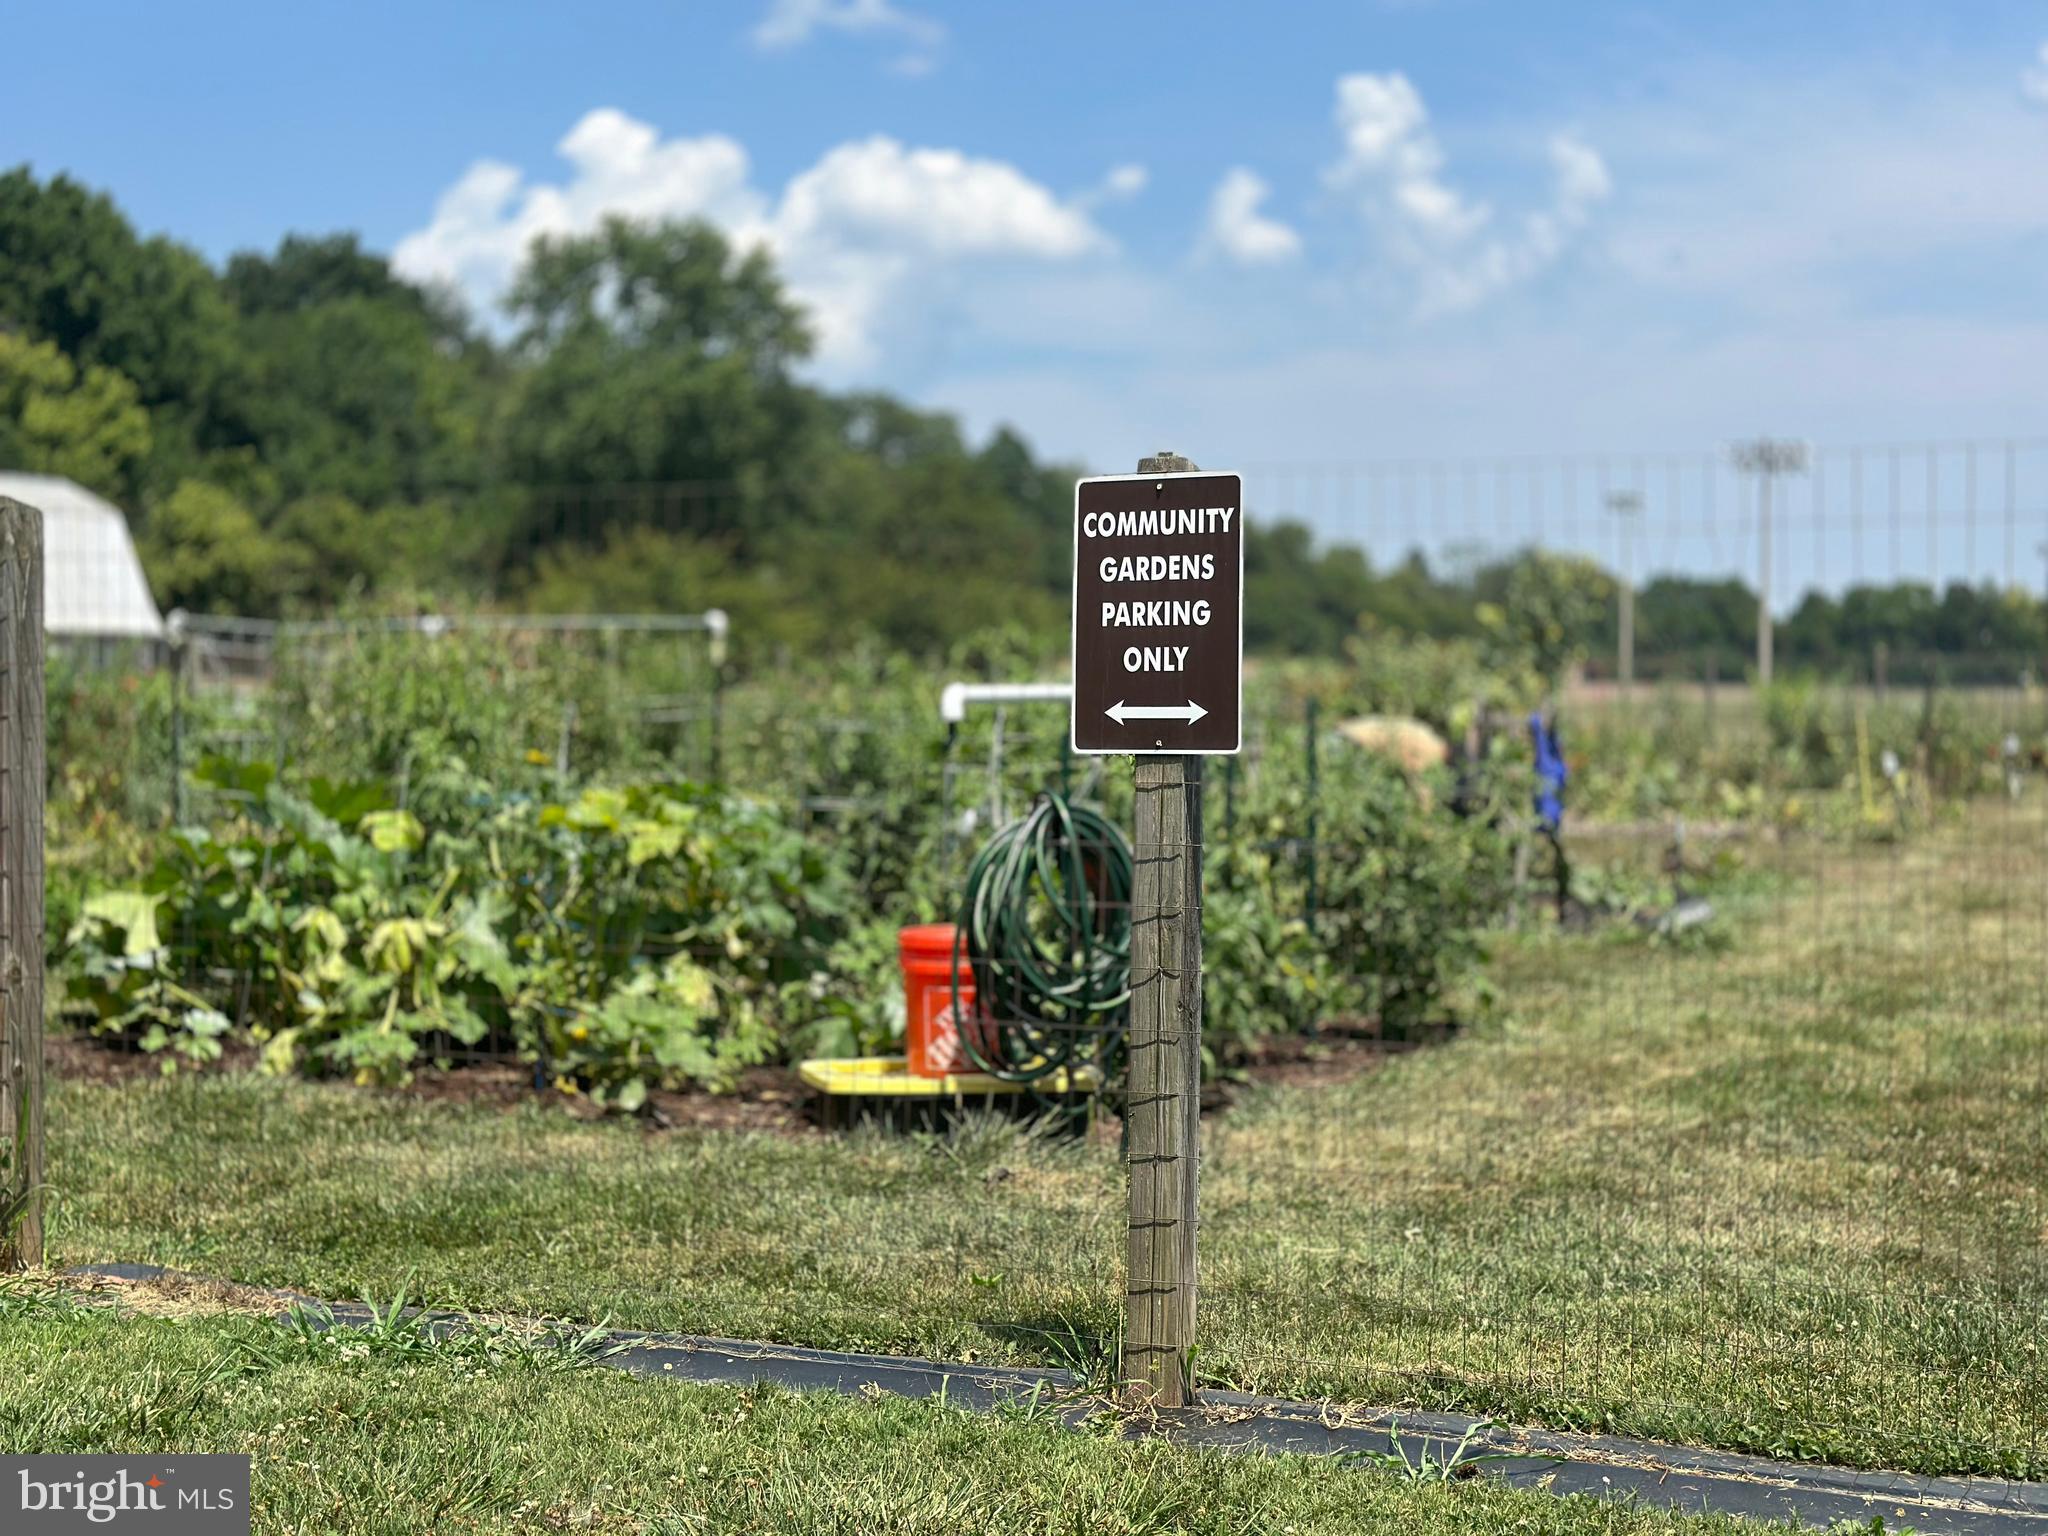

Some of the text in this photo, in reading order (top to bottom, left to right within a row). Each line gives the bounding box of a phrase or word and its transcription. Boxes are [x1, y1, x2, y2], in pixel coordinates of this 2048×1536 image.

[1083, 507, 1235, 538] COMMUNITY
[1100, 553, 1215, 582] GARDENS
[1102, 600, 1211, 627] PARKING
[1123, 646, 1189, 672] ONLY
